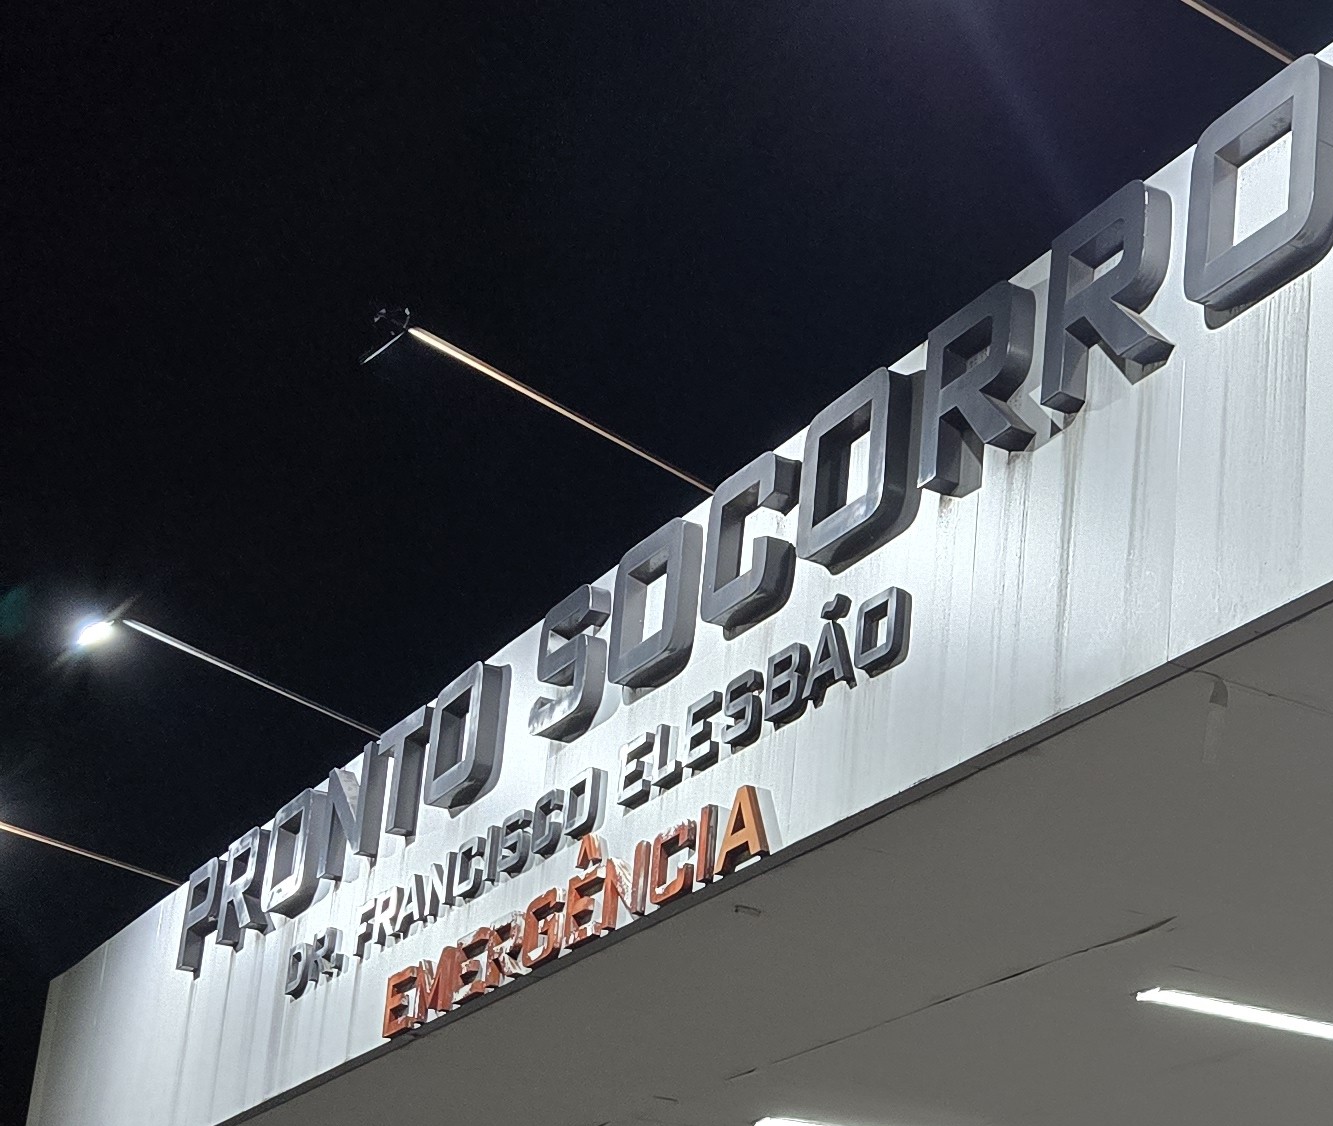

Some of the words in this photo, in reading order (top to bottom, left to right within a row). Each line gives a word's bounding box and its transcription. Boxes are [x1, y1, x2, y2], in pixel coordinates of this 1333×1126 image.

[176, 661, 511, 974] PRONTO
[284, 926, 345, 999] DR.
[352, 767, 608, 959] FRANCISCO
[617, 586, 912, 812] ELESBÃO
[381, 785, 771, 1041] EMERGÊNCIA
